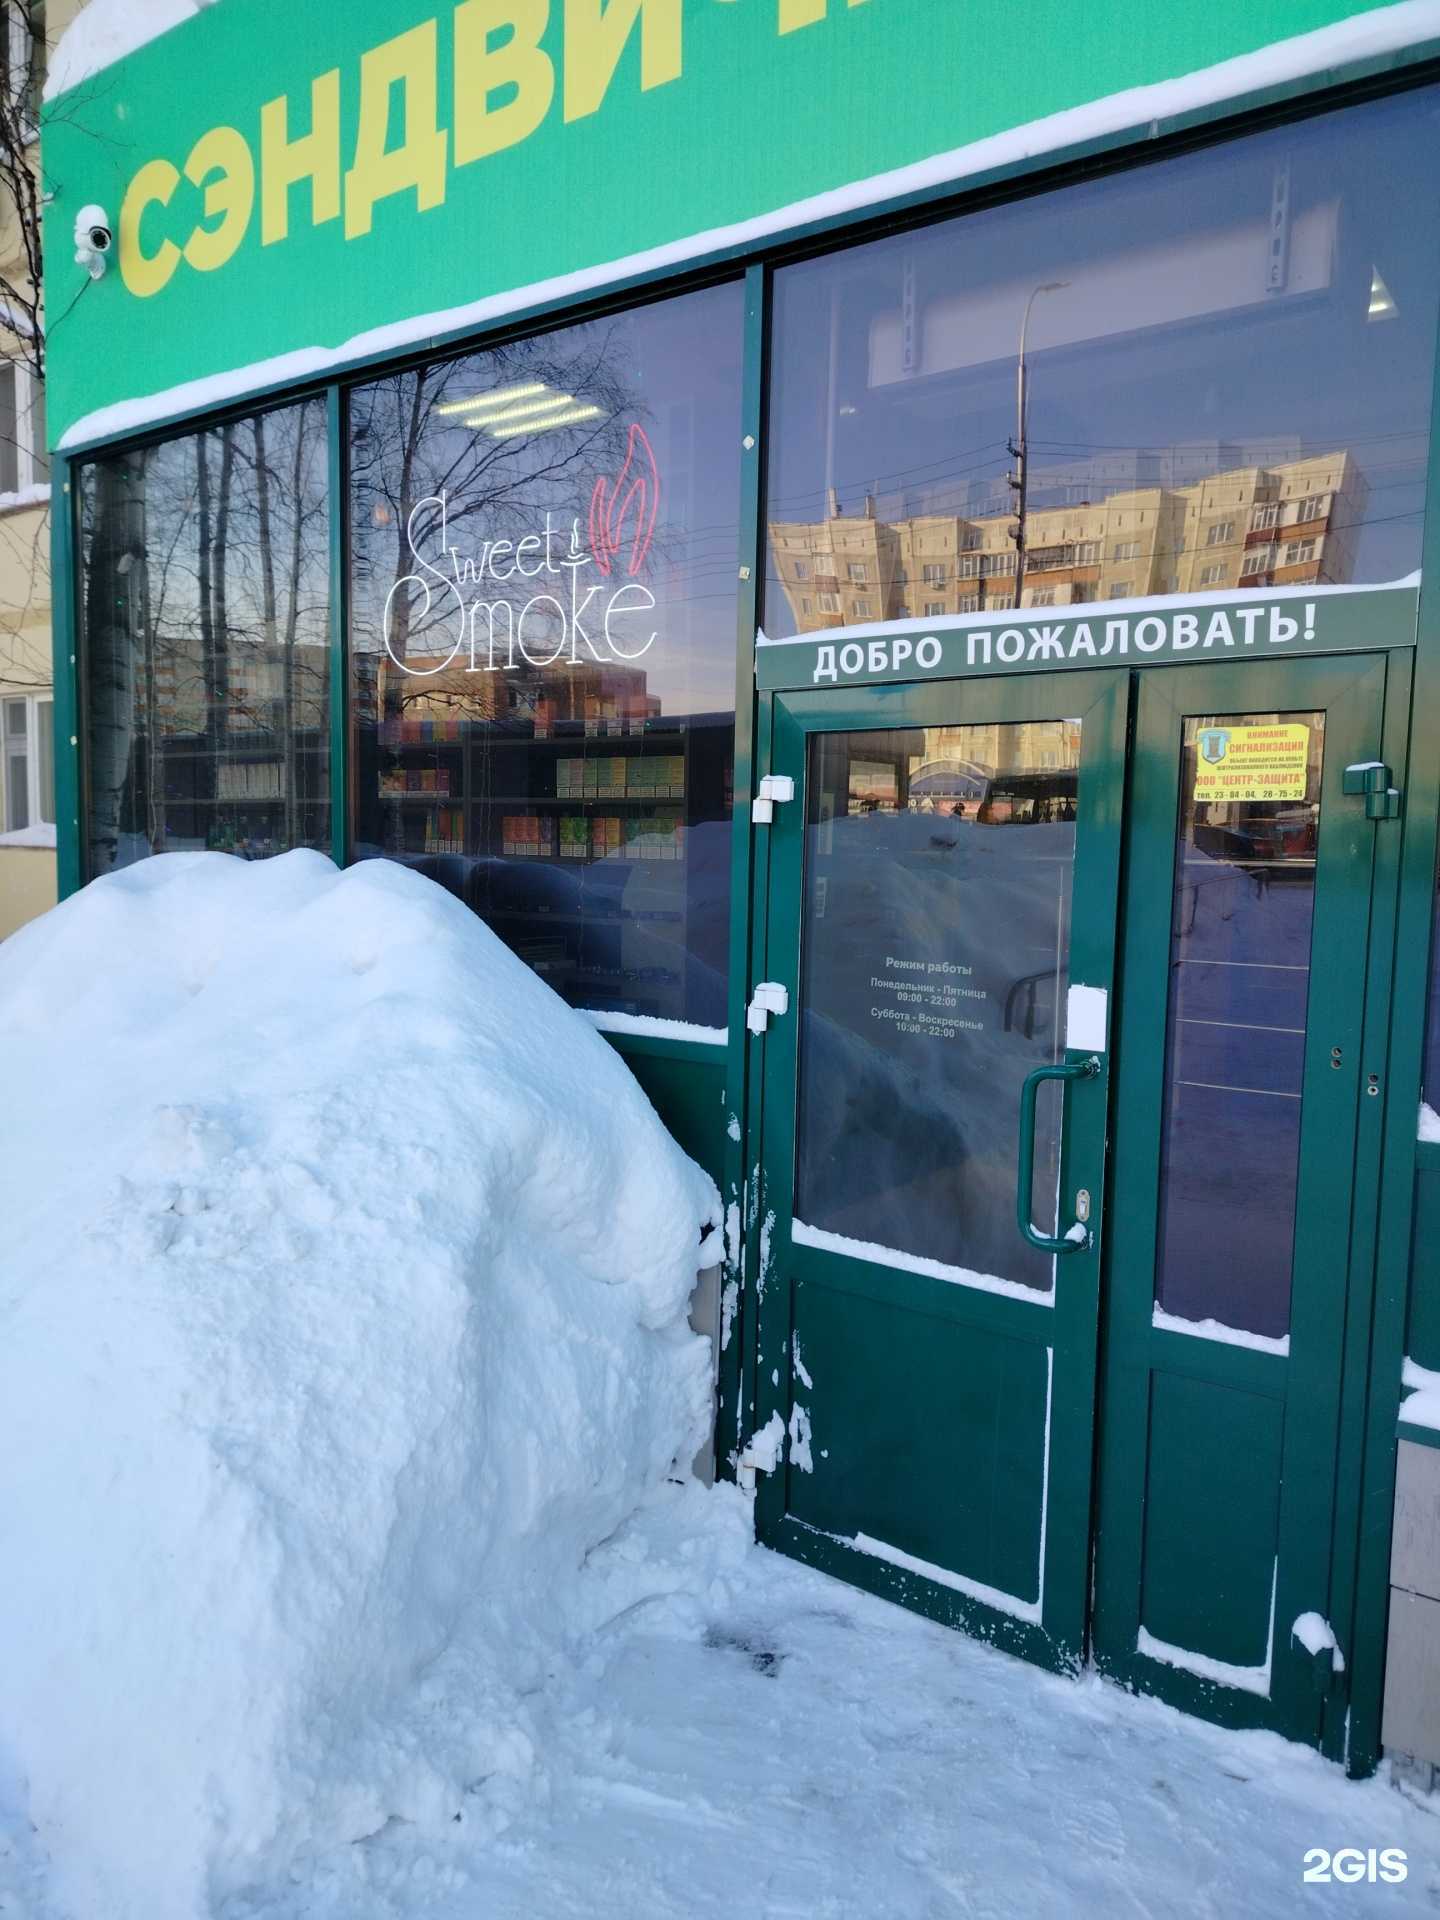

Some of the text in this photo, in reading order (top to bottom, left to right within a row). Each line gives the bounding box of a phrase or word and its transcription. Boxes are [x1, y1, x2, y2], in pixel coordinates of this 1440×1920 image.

[407, 489, 561, 586] Sweet
[383, 563, 658, 675] Smoke
[812, 603, 1317, 684] ДОБРО ПОЖАЛОВАТЬ!
[1197, 774, 1216, 786] ООО
[885, 956, 972, 976] Режим работы
[870, 976, 935, 994] Понедельник
[943, 984, 987, 999] Пятница
[897, 991, 922, 1003] 09:00
[930, 995, 957, 1007] 22:00
[870, 1007, 910, 1021] Суббота
[918, 1012, 984, 1031] Воскресенье
[896, 1021, 921, 1034] 10:00
[929, 1026, 955, 1038] 22:00
